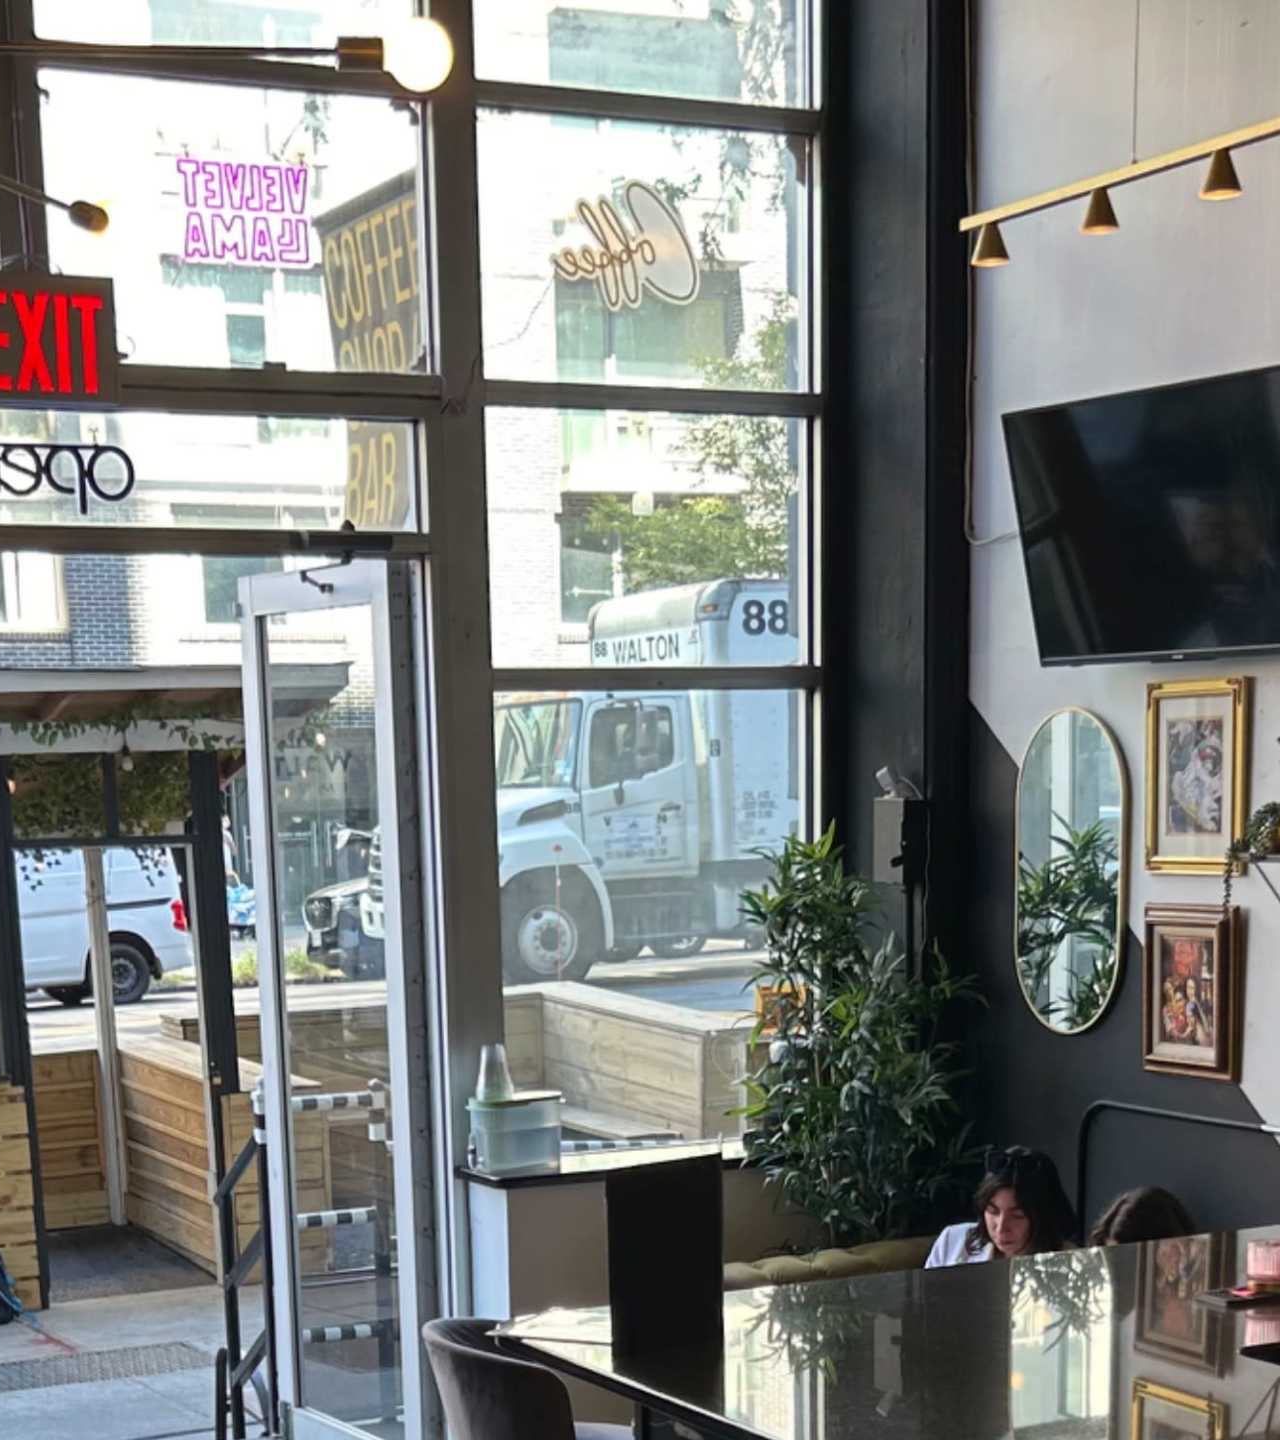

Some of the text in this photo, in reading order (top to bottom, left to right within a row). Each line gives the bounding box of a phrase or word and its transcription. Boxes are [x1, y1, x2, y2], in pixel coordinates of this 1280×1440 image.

[347, 431, 397, 526] BAR
[742, 598, 788, 637] 88
[612, 633, 680, 664] WALTON
